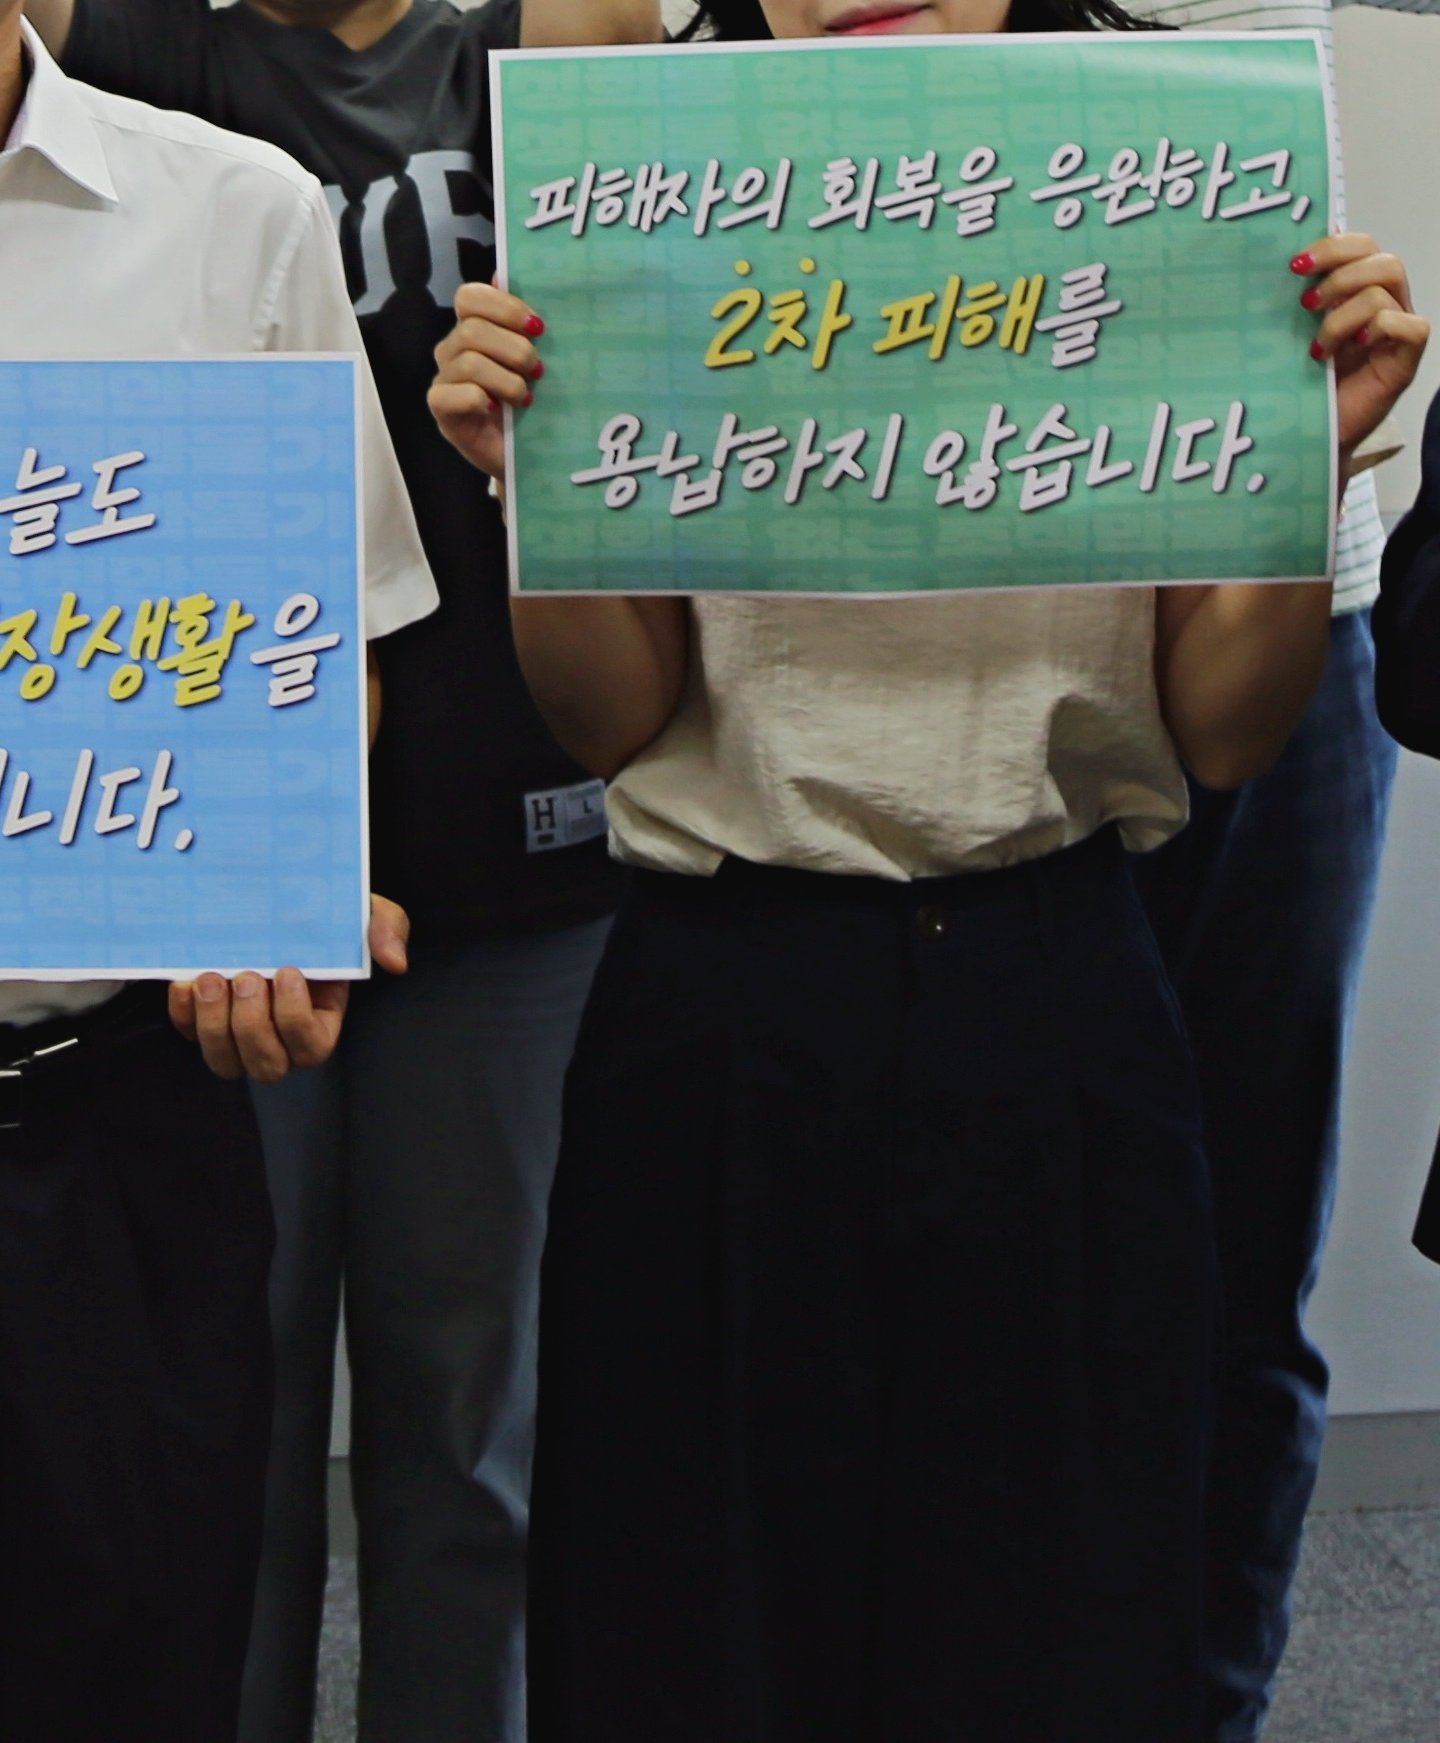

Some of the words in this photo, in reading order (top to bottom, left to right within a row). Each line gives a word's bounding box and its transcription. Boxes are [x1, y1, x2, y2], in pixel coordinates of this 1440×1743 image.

[524, 158, 792, 237] 피해자의
[808, 145, 1013, 237] 회복을
[1029, 137, 1312, 228] 응원하고,
[703, 278, 852, 370] 2차
[871, 262, 1122, 369] 피해를
[570, 411, 904, 517] 용납하지
[923, 401, 1267, 512] 않습니다.
